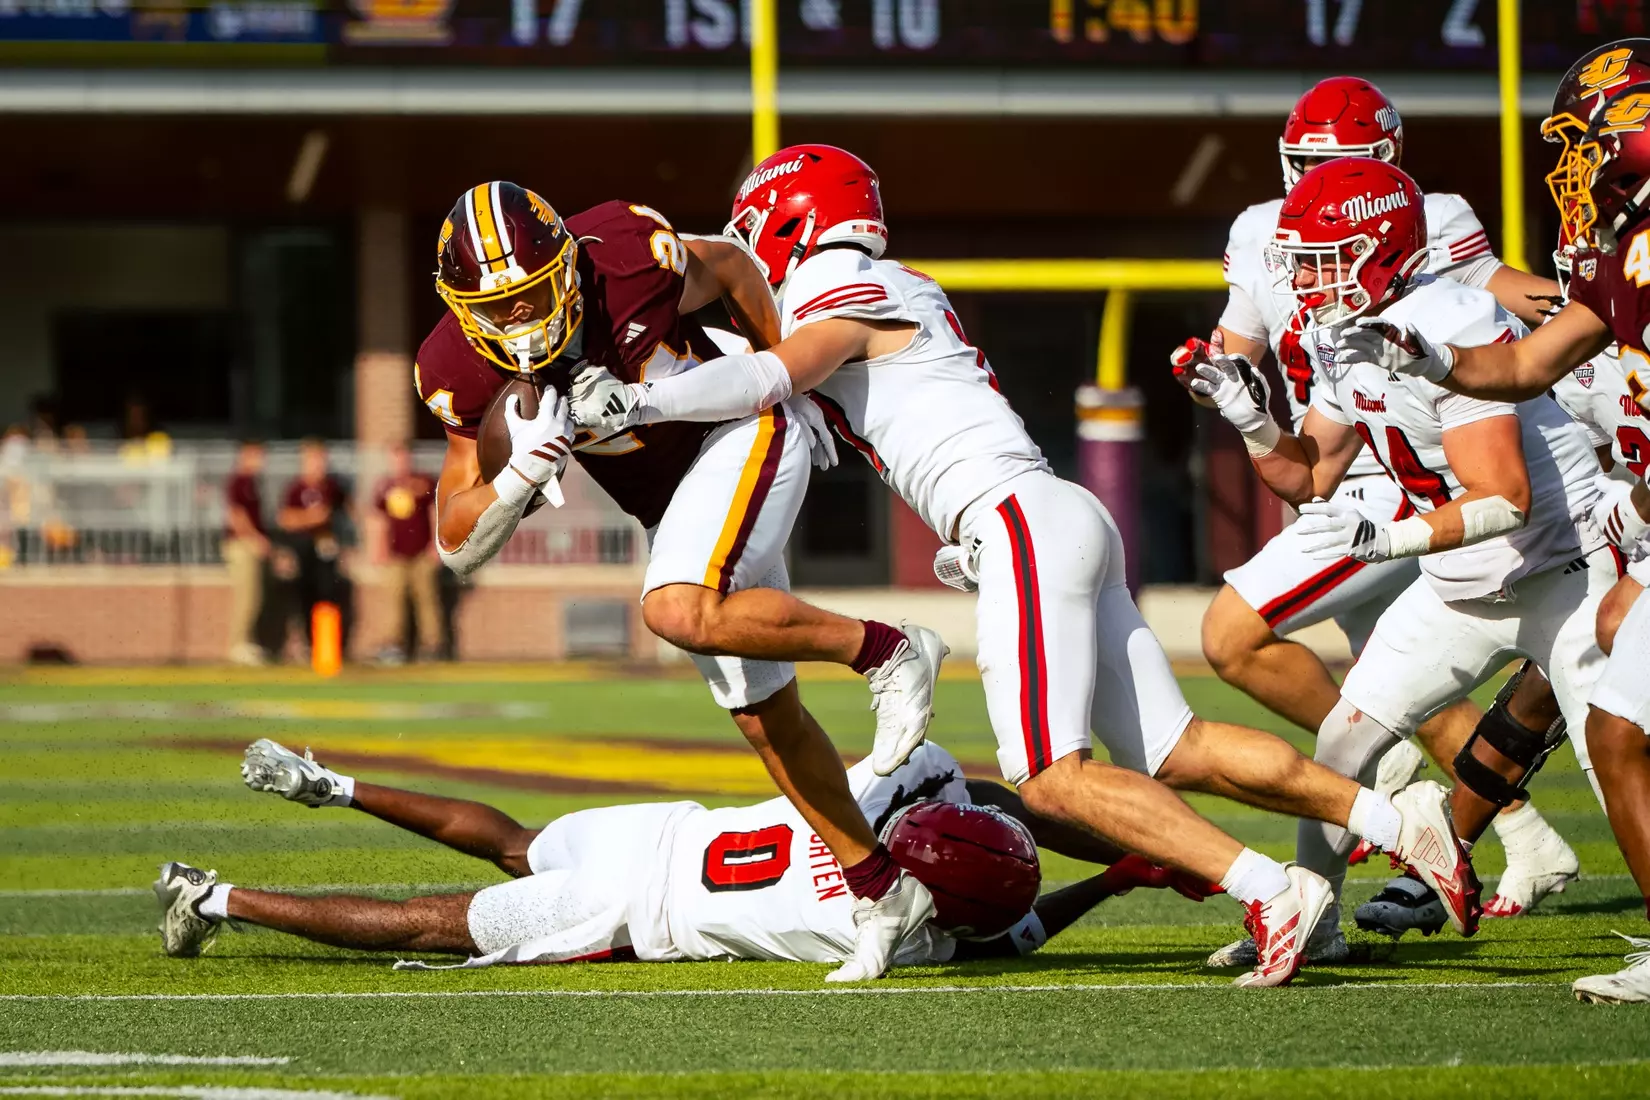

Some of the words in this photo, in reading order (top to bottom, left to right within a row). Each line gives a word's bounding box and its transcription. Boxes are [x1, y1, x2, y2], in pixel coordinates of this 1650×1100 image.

[739, 154, 805, 199] Miami
[1341, 182, 1409, 222] Miami
[1352, 389, 1387, 413] Miami
[701, 823, 794, 893] 0
